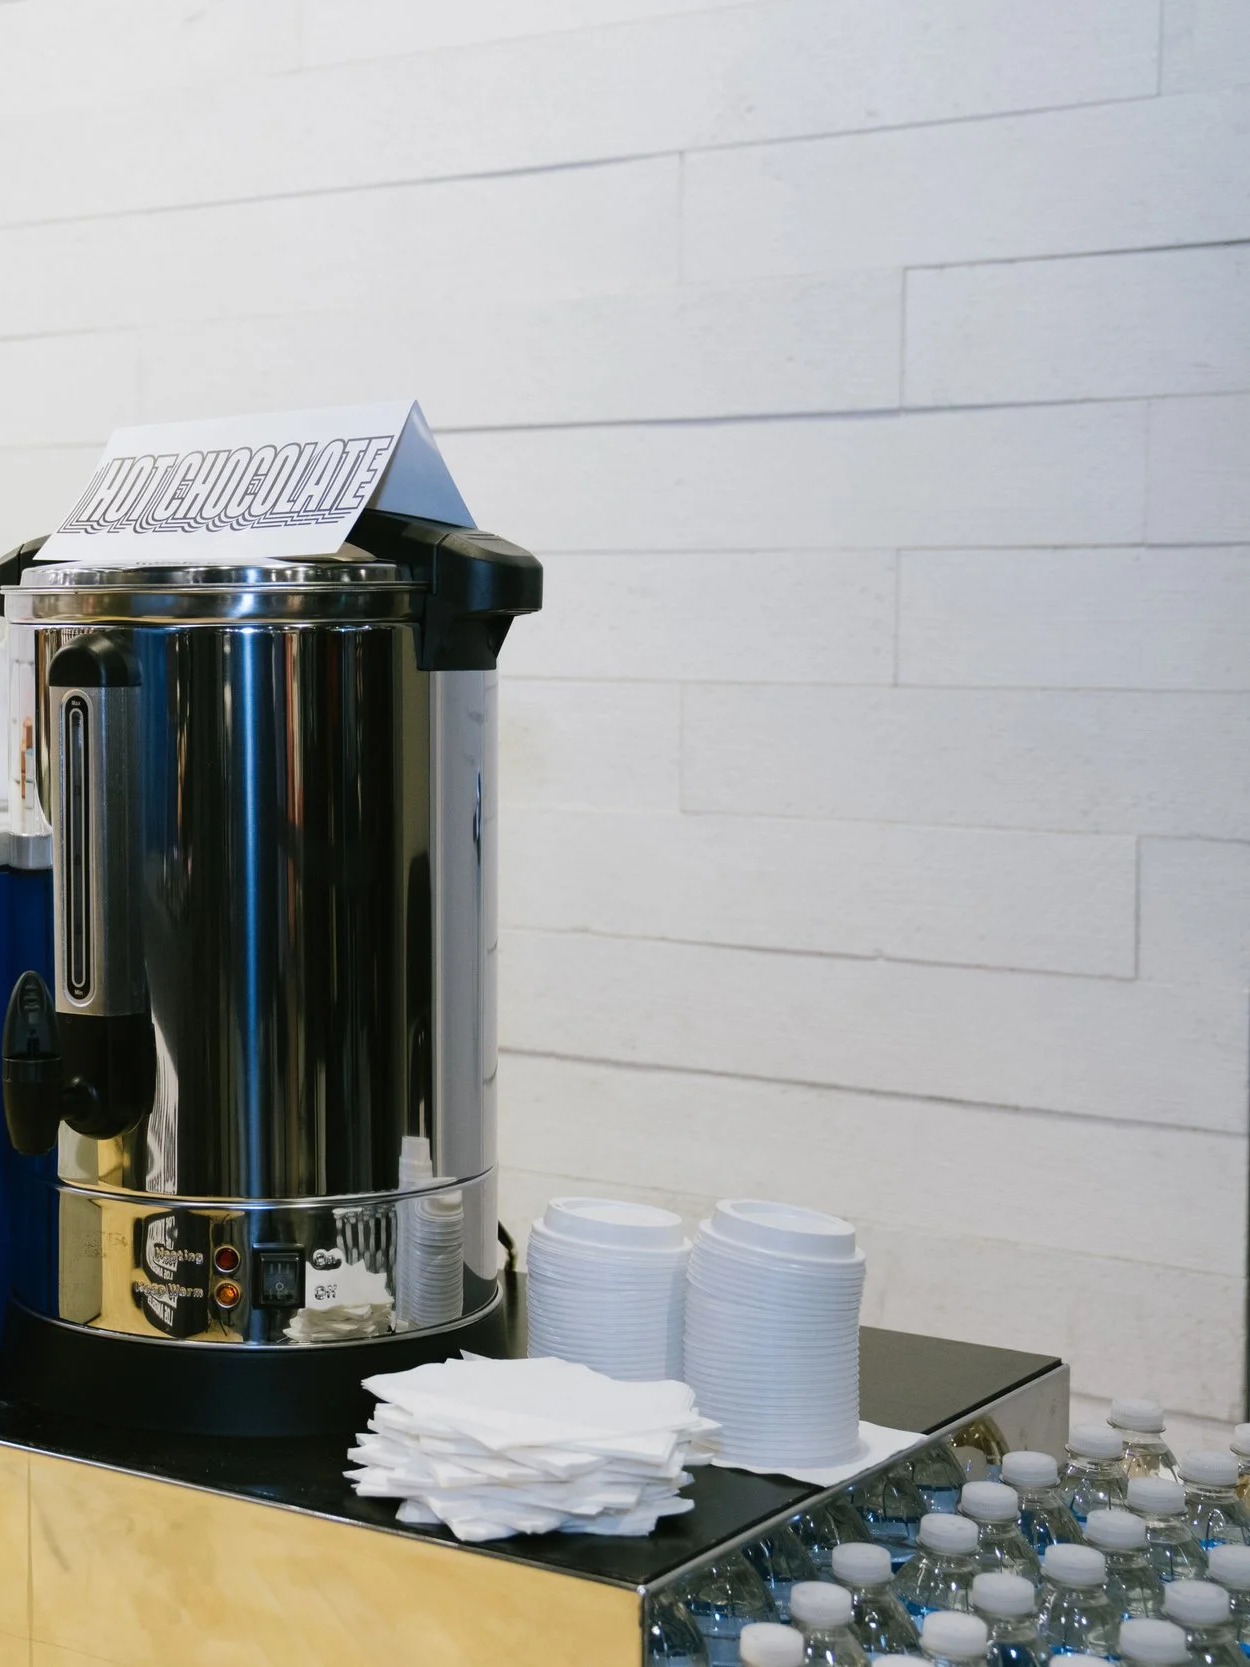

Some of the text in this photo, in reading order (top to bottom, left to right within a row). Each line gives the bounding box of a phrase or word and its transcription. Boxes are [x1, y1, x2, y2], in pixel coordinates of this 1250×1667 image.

[57, 435, 395, 534] HOT CHOCOLATE
[154, 1246, 204, 1265] Heating
[134, 1280, 204, 1298] Keep Warm
[314, 1284, 338, 1300] Off
